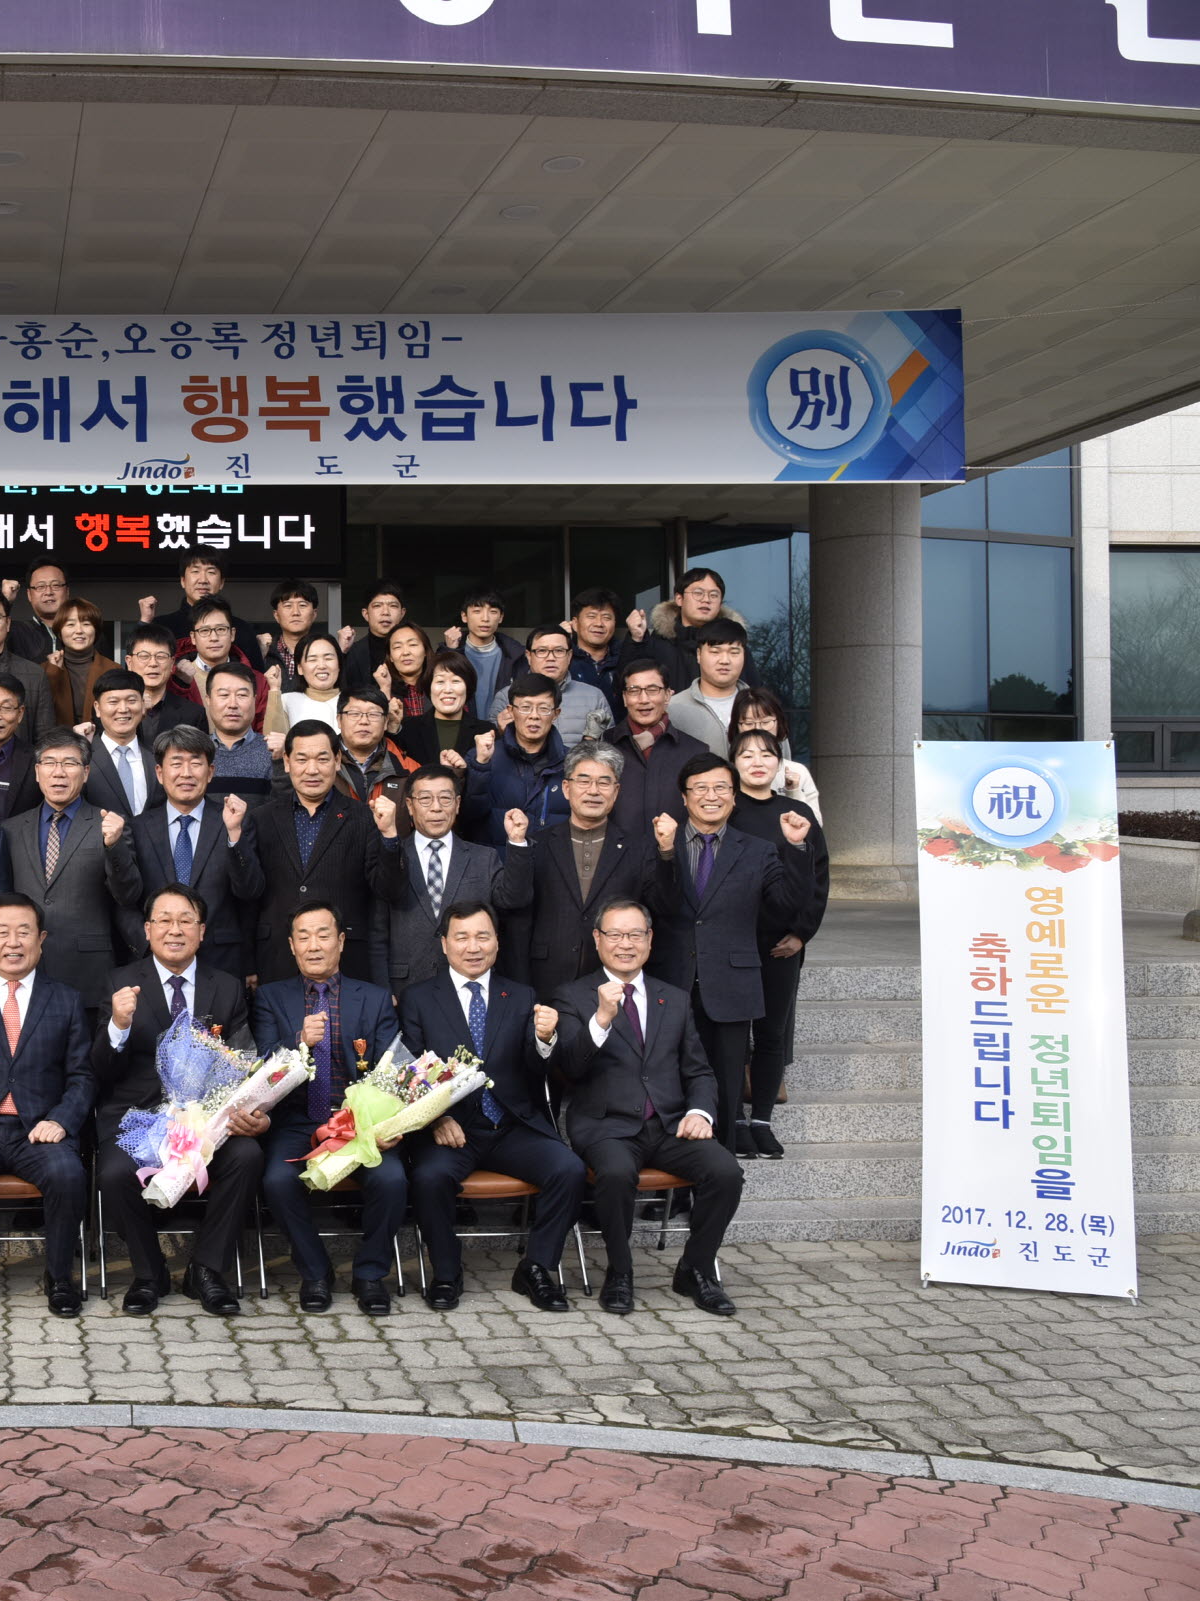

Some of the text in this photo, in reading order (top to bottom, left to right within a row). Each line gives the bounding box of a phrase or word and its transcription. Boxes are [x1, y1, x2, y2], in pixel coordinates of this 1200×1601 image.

[181, 375, 637, 442] 행복했습니다
[787, 365, 851, 431] 別
[117, 460, 183, 480] Jindo
[74, 513, 316, 551] 행복했습니다
[988, 784, 1042, 820] 祝
[968, 932, 1015, 1130] 축하드립니다
[1025, 886, 1076, 1201] 영예로운 정년퇴임을
[941, 1205, 992, 1228] 2017.
[1005, 1210, 1033, 1231] 12.
[940, 1240, 991, 1259] Jindo
